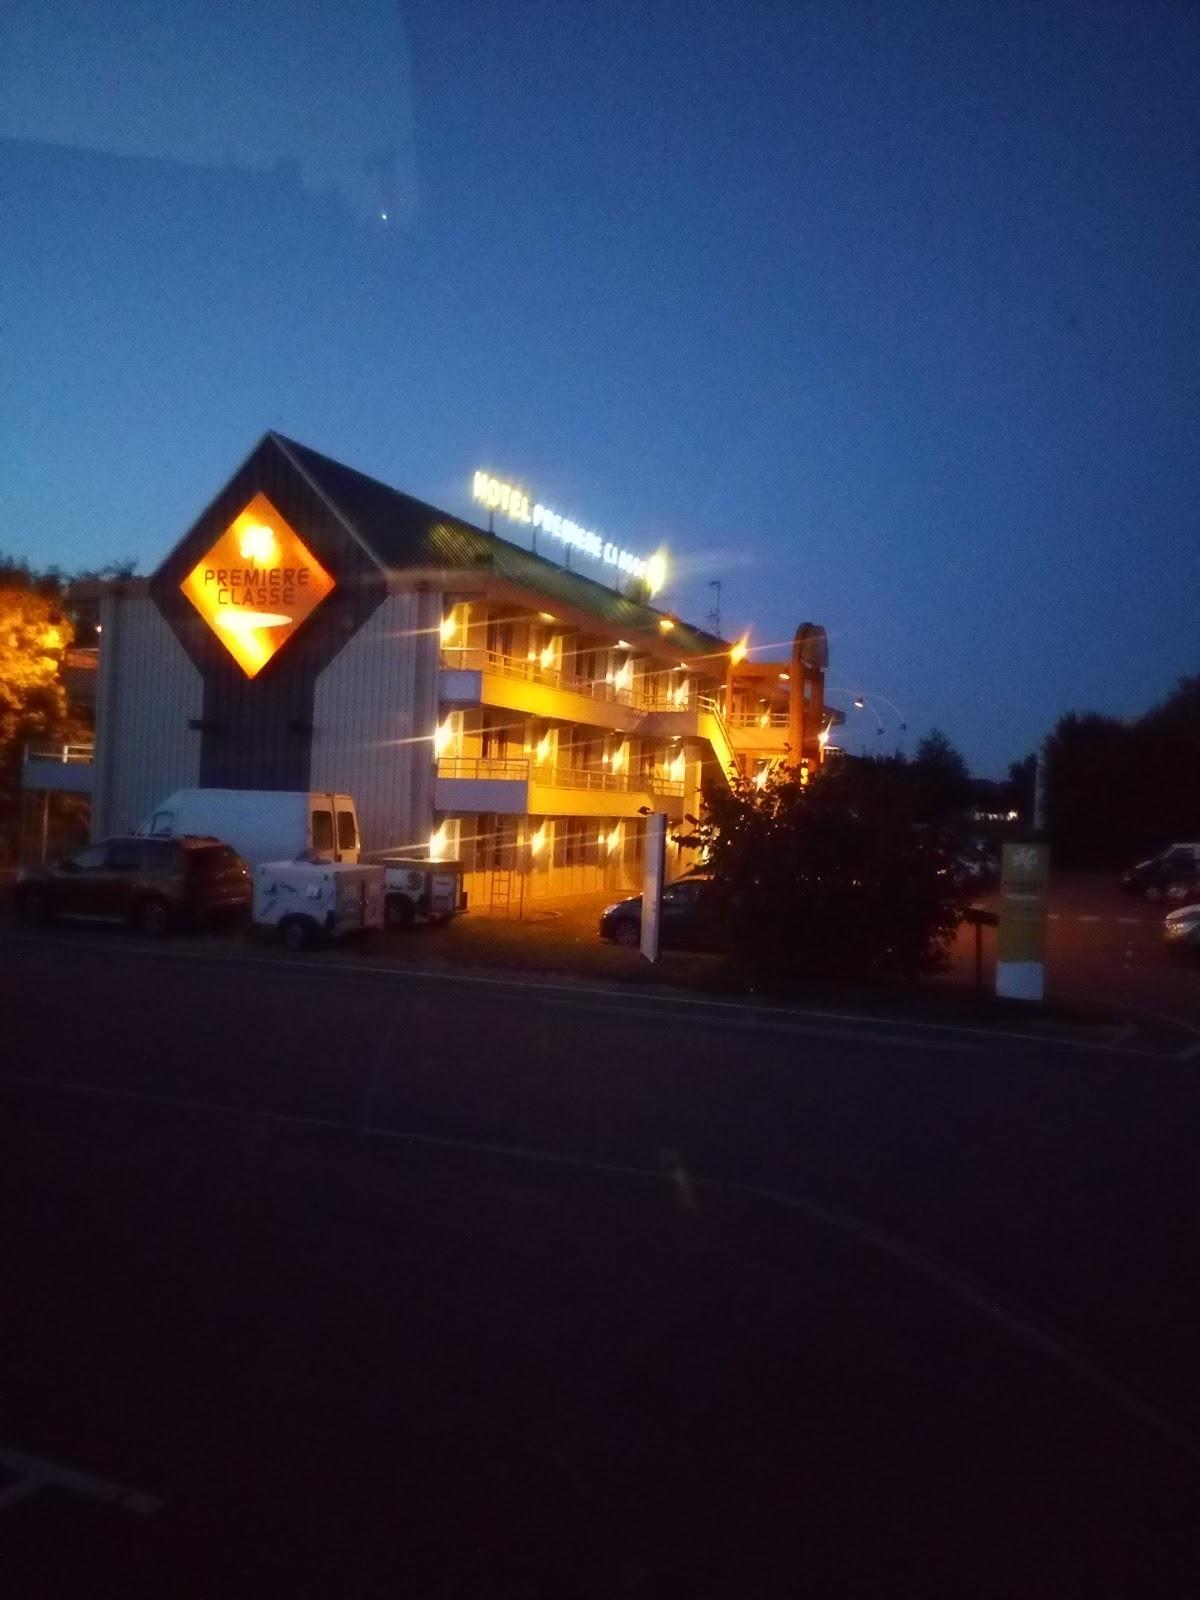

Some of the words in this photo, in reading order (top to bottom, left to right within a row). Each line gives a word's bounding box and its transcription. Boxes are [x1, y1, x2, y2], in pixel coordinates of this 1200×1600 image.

[473, 471, 531, 523] HOTEL
[204, 568, 309, 587] PREMIERE
[218, 588, 296, 606] CLASSE
